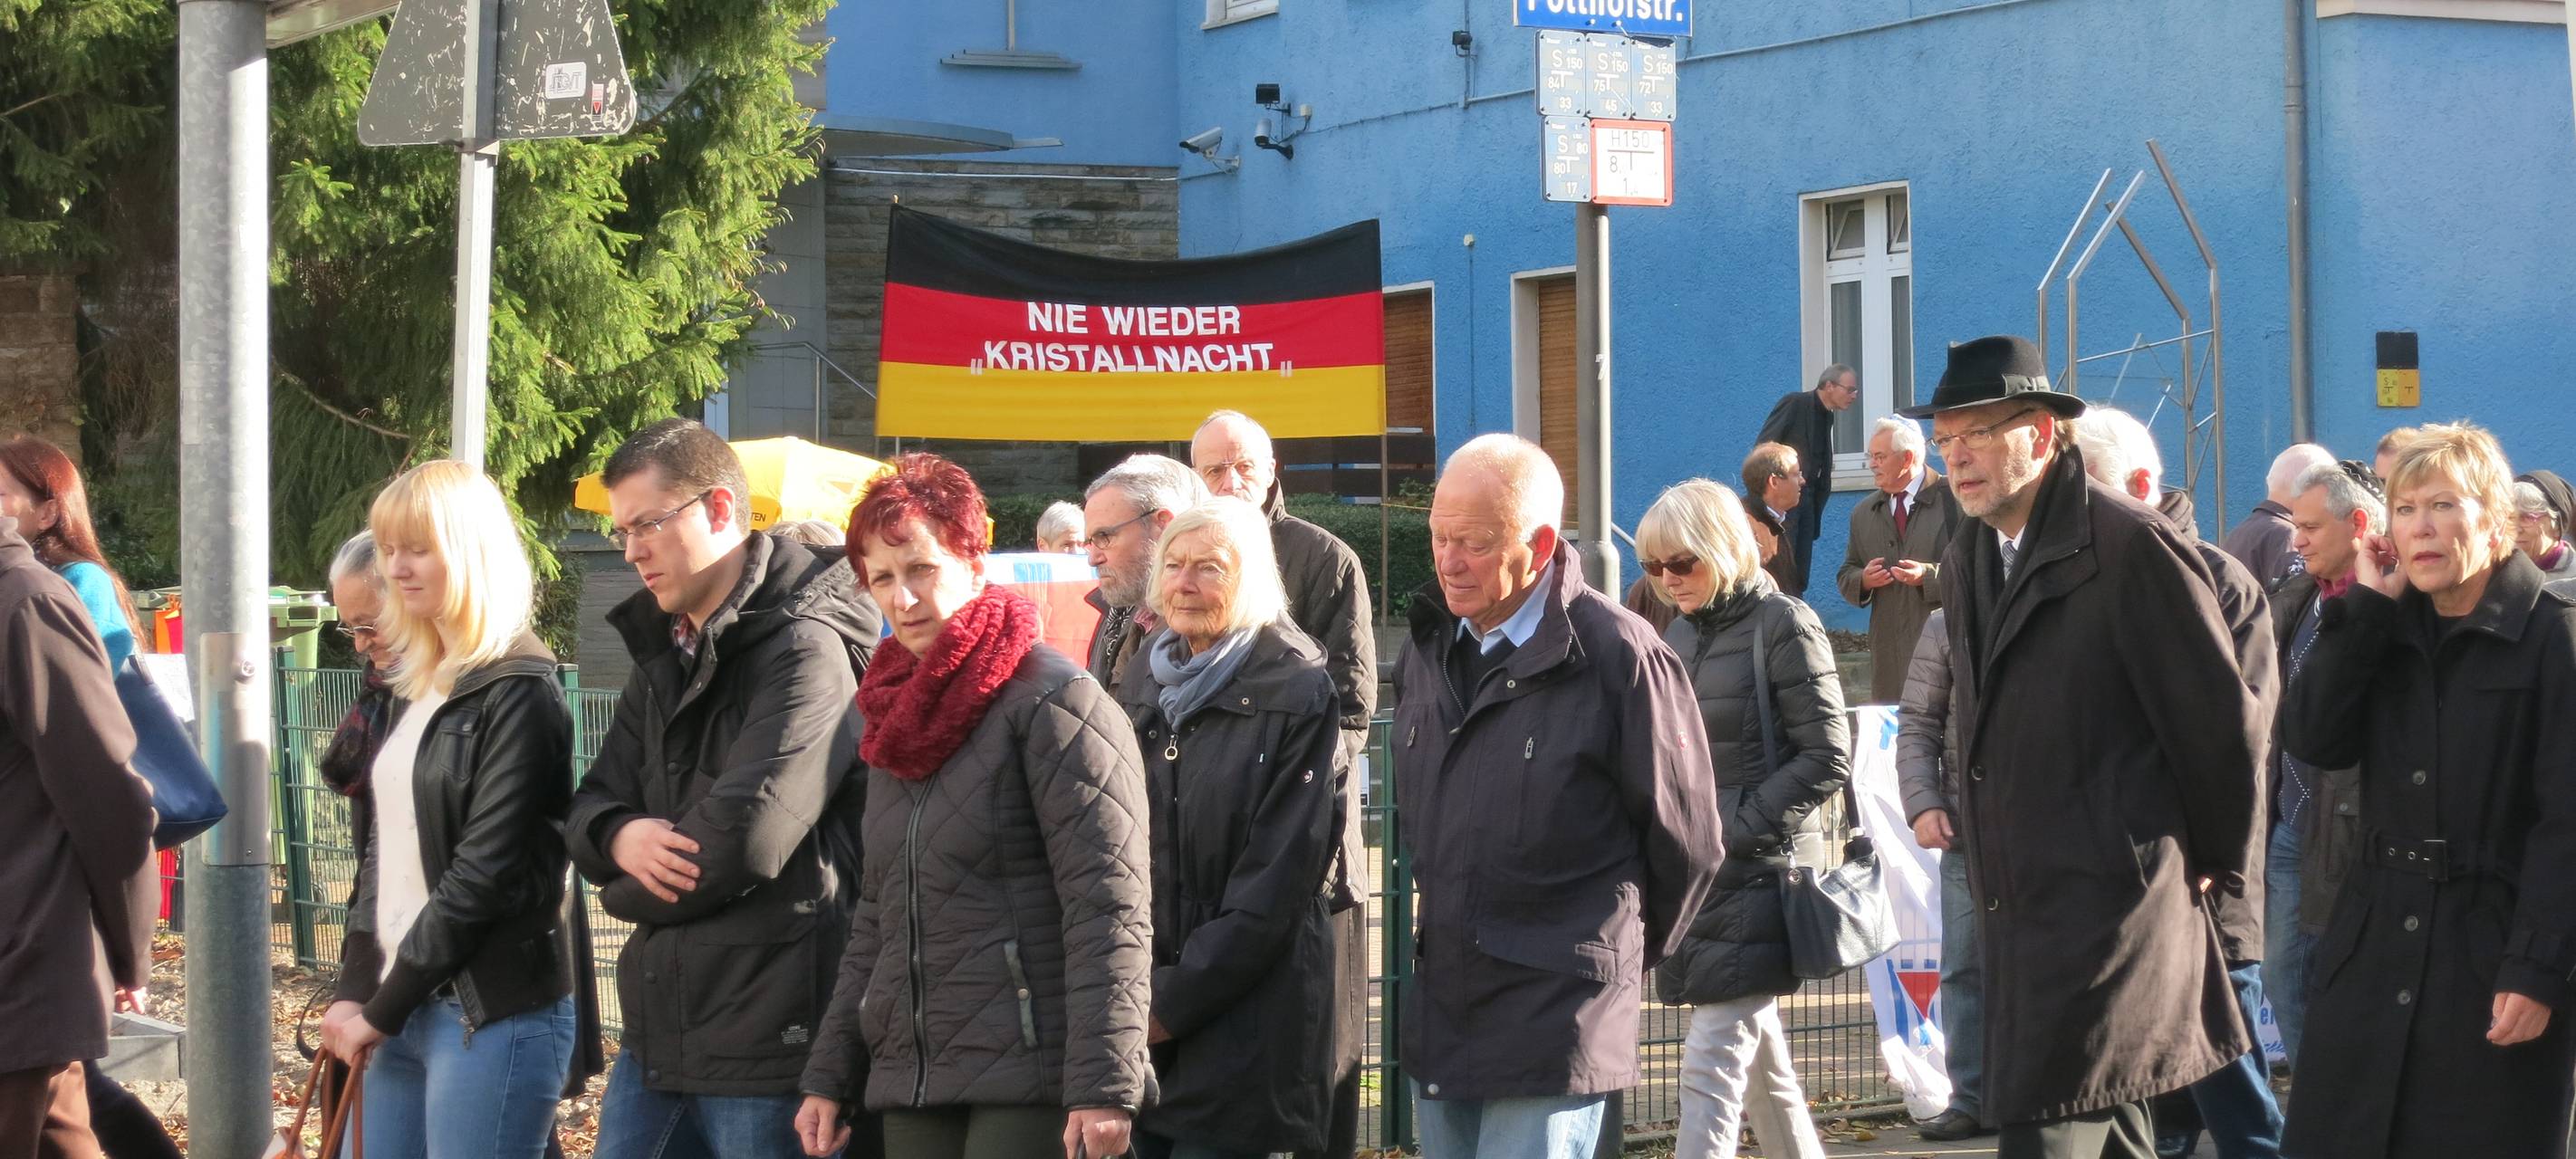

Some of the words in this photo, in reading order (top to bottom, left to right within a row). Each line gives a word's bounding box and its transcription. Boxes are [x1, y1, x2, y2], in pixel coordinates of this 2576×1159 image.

[1552, 49, 1562, 68] S
[1566, 56, 1583, 70] 150
[1597, 53, 1609, 71] S
[1611, 59, 1629, 72] 150
[1643, 55, 1653, 73] S
[1558, 134, 1568, 153] S
[1576, 141, 1589, 155] 80
[1027, 302, 1088, 334] NIE
[1101, 305, 1241, 336] WIEDER
